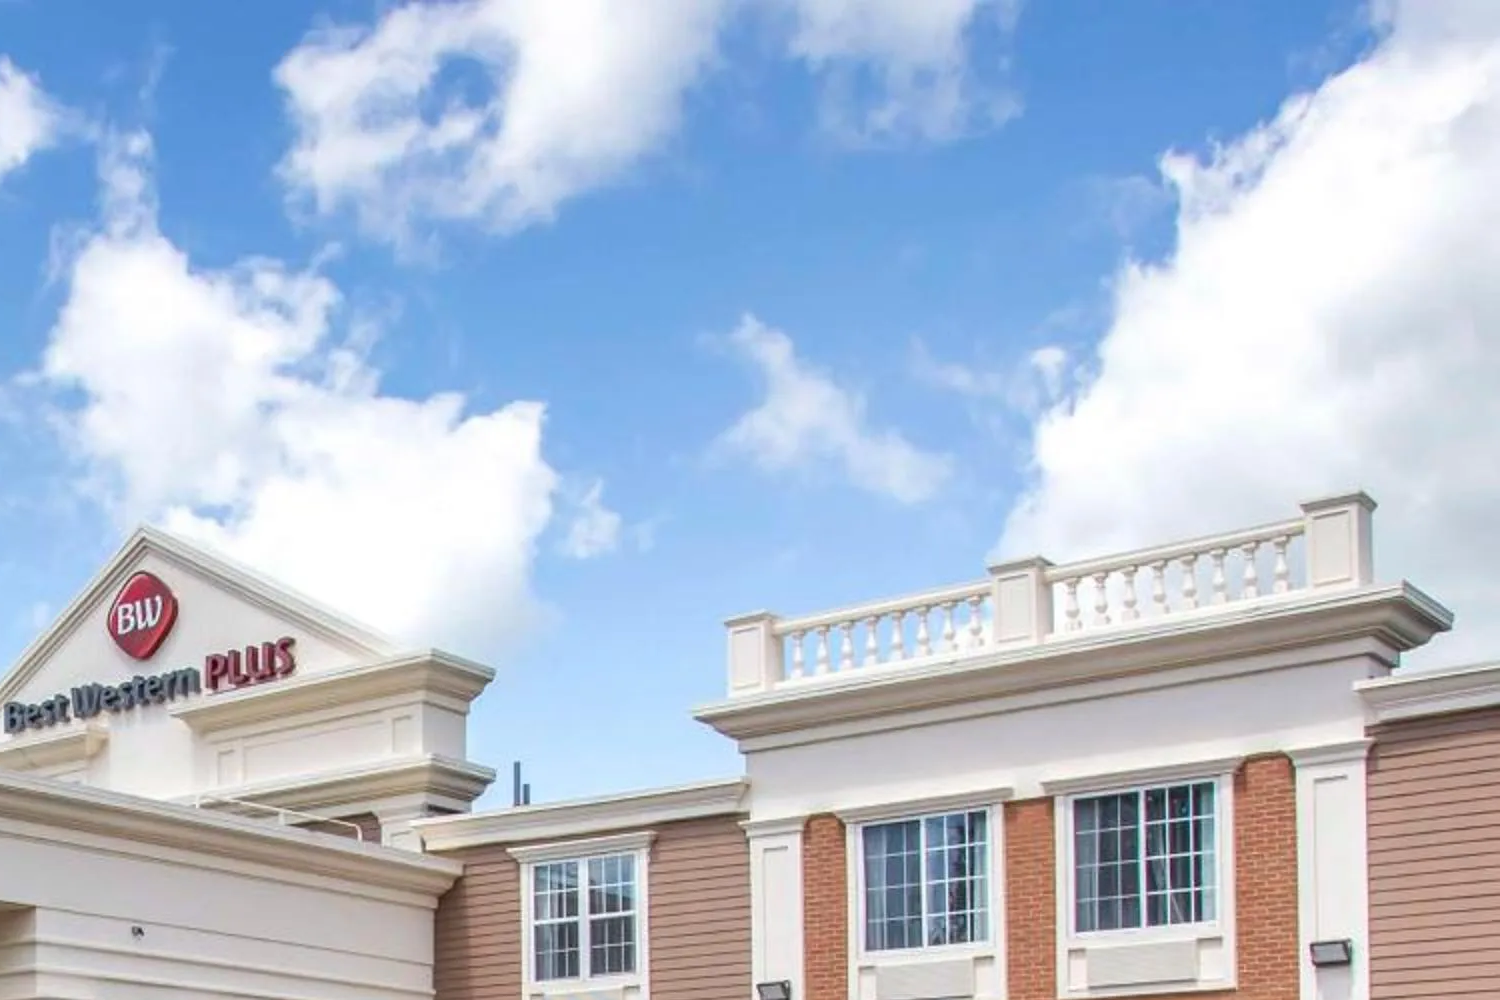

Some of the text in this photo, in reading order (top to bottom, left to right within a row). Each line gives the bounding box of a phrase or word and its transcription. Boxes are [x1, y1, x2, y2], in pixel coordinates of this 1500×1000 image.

[116, 595, 164, 635] BW
[3, 636, 297, 734] Best Western PLUS
